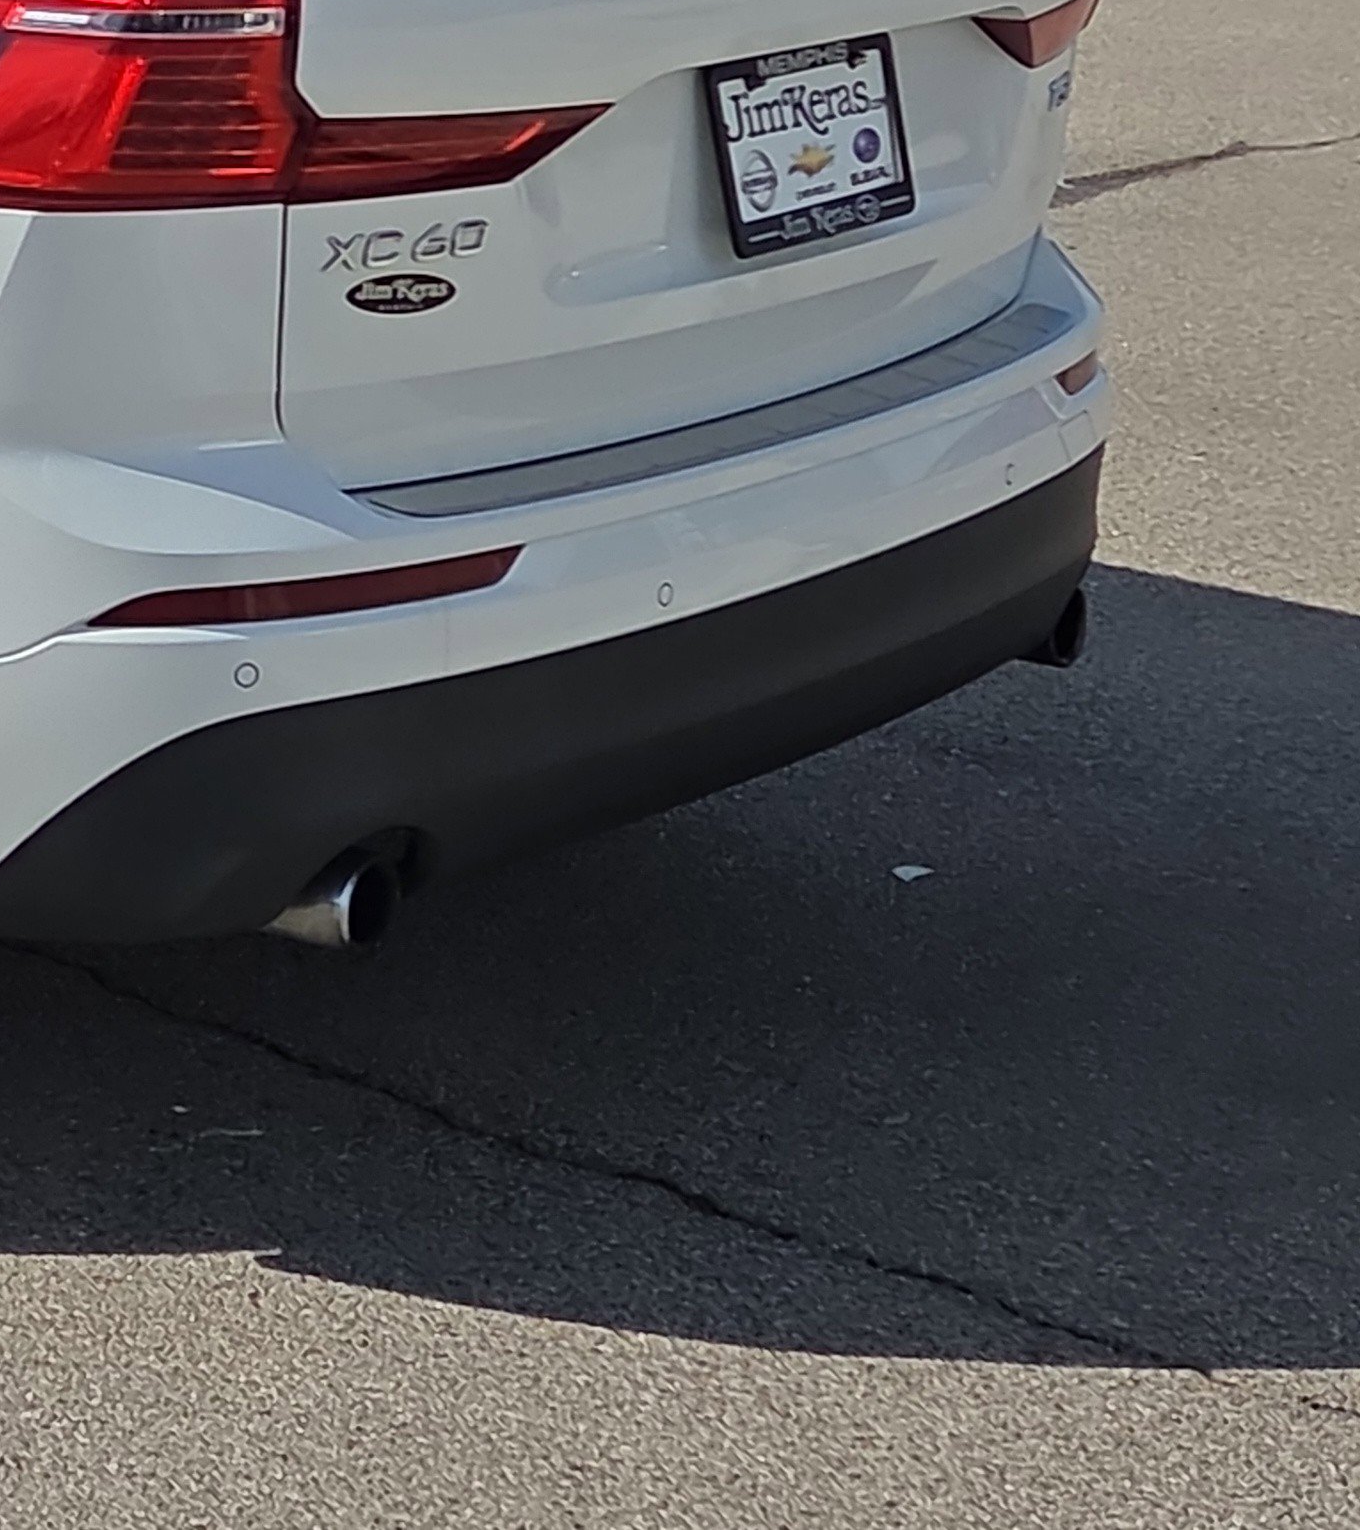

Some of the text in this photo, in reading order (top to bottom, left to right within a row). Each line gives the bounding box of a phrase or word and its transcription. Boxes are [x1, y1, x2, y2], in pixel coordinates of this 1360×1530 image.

[756, 42, 848, 77] MEMPHIS
[727, 81, 868, 142] Jim Keras
[321, 218, 489, 272] XC60
